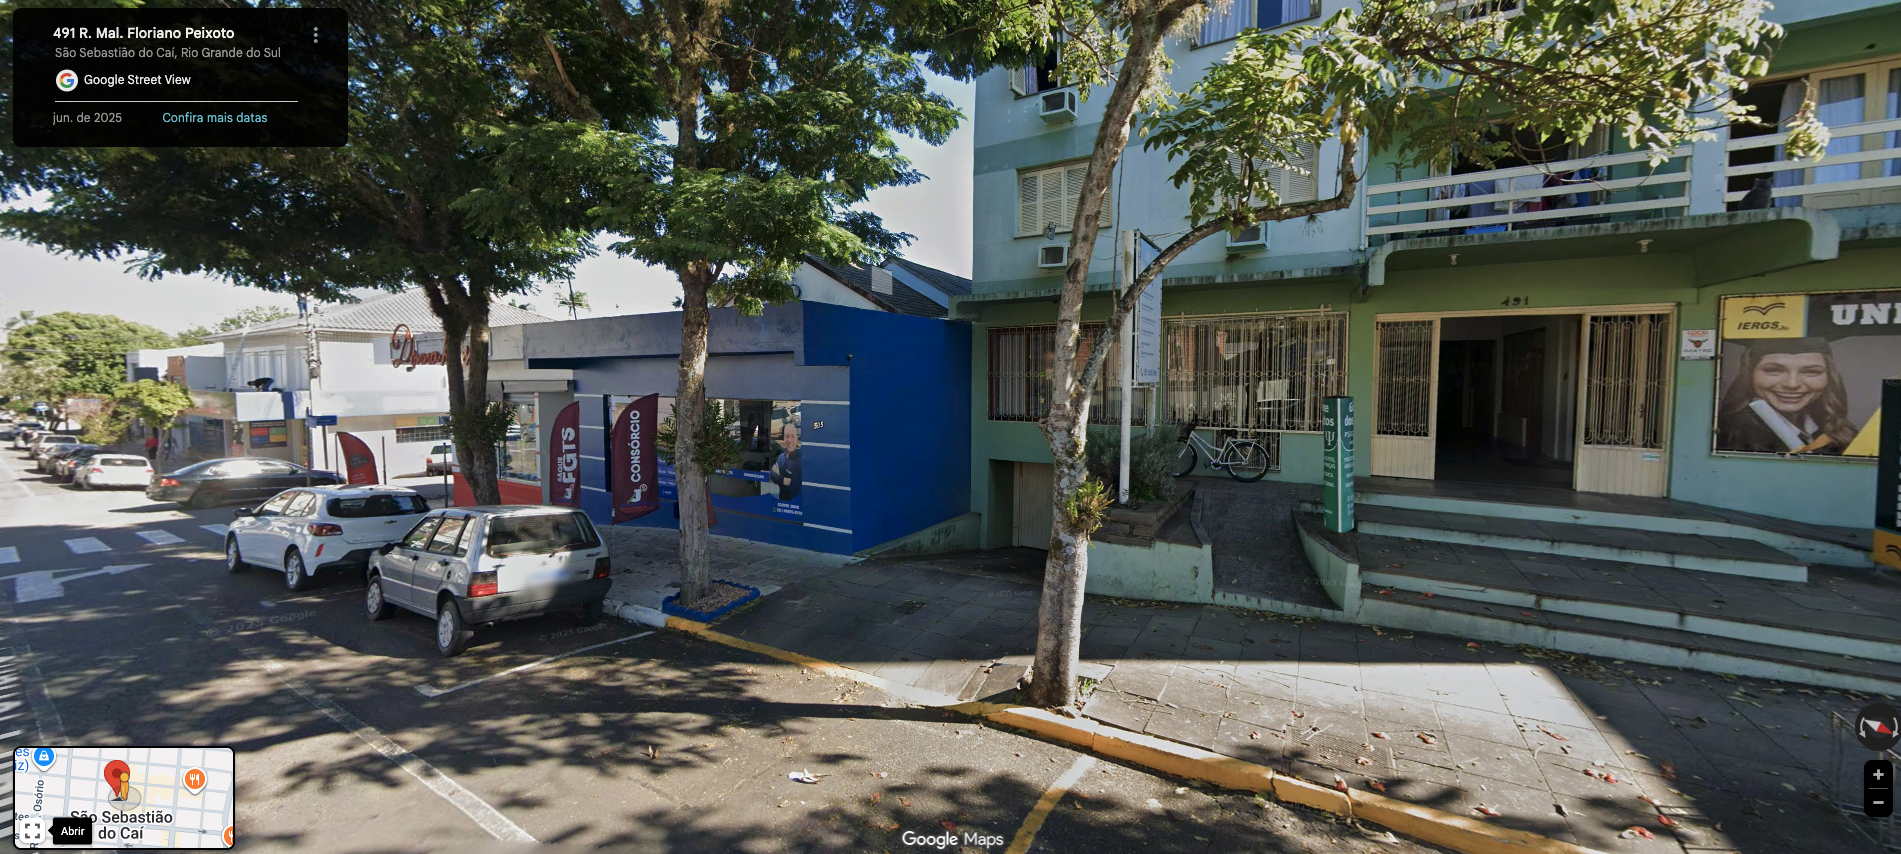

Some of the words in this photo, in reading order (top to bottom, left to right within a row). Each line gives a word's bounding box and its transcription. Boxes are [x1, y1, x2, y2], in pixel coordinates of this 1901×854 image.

[1501, 296, 1529, 306] 491
[1737, 321, 1779, 331] IERGS
[562, 427, 578, 484] FGTS
[628, 410, 641, 482] CONSÓRCIO
